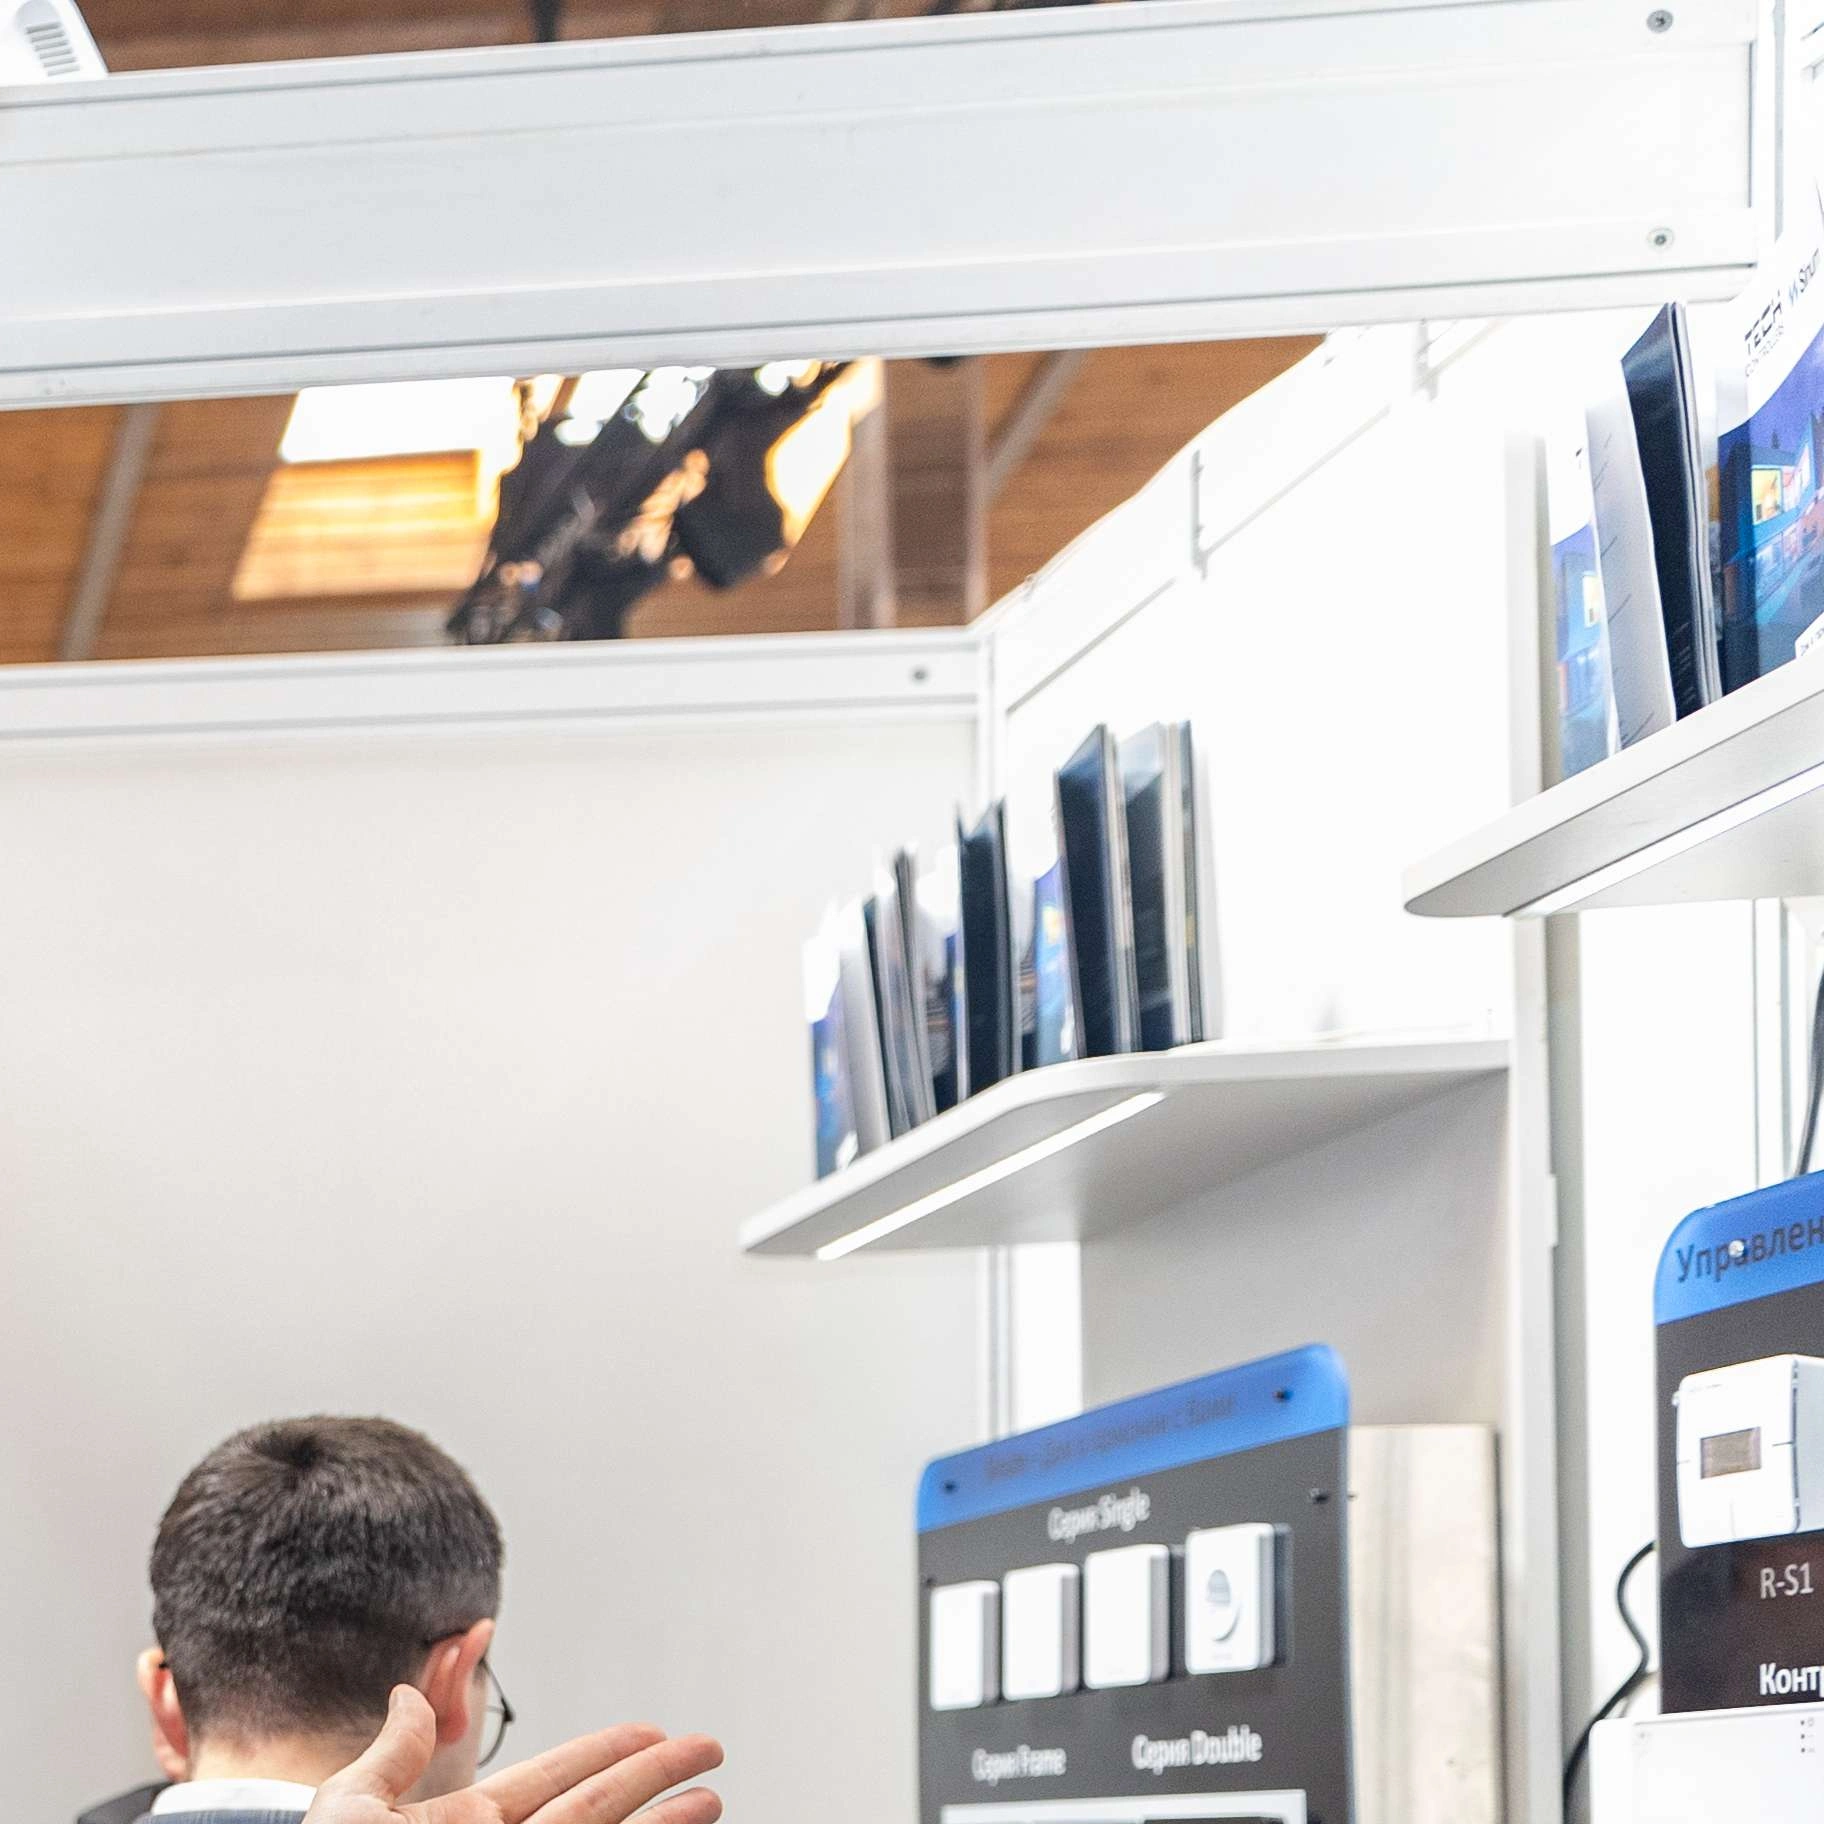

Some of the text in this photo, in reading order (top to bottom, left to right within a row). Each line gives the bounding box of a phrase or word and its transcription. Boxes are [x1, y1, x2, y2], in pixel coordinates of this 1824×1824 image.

[1760, 1561, 1814, 1599] R-S1
[1131, 1724, 1262, 1776] Серия Double
